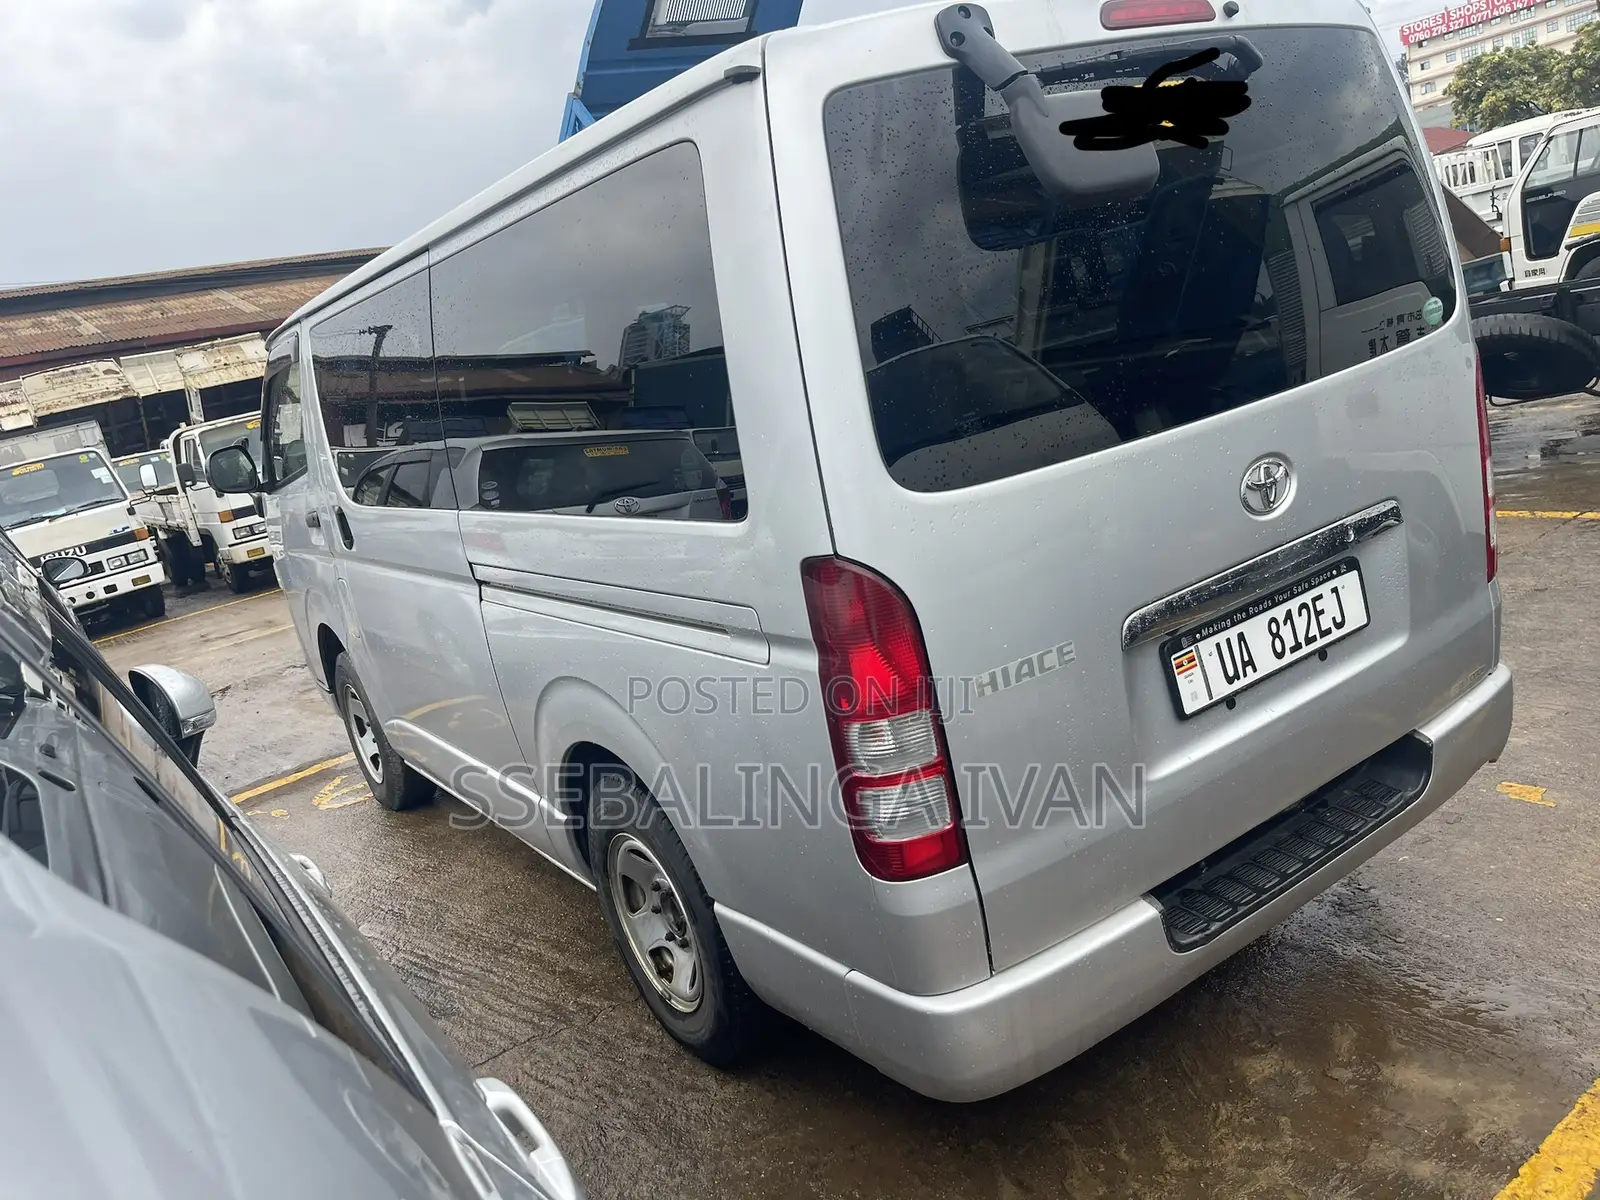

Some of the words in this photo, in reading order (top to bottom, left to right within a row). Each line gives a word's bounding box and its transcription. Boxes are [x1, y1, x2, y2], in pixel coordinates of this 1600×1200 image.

[1402, 15, 1443, 35] STORES
[1449, 0, 1487, 20] SHOPS
[1408, 30, 1431, 43] 0760
[1431, 24, 1447, 36] 276
[1448, 18, 1465, 31] 327
[1470, 10, 1491, 24] 0771
[1493, 3, 1511, 16] 406
[1201, 618, 1231, 637] Making
[1233, 610, 1247, 623] the
[1248, 600, 1272, 615] Roads
[1274, 591, 1291, 603] Your
[1292, 582, 1309, 595] Safe
[1310, 571, 1331, 587] Space
[1215, 631, 1258, 685] UA
[1267, 585, 1346, 660] 812EJ
[975, 640, 1077, 697] HIACE
